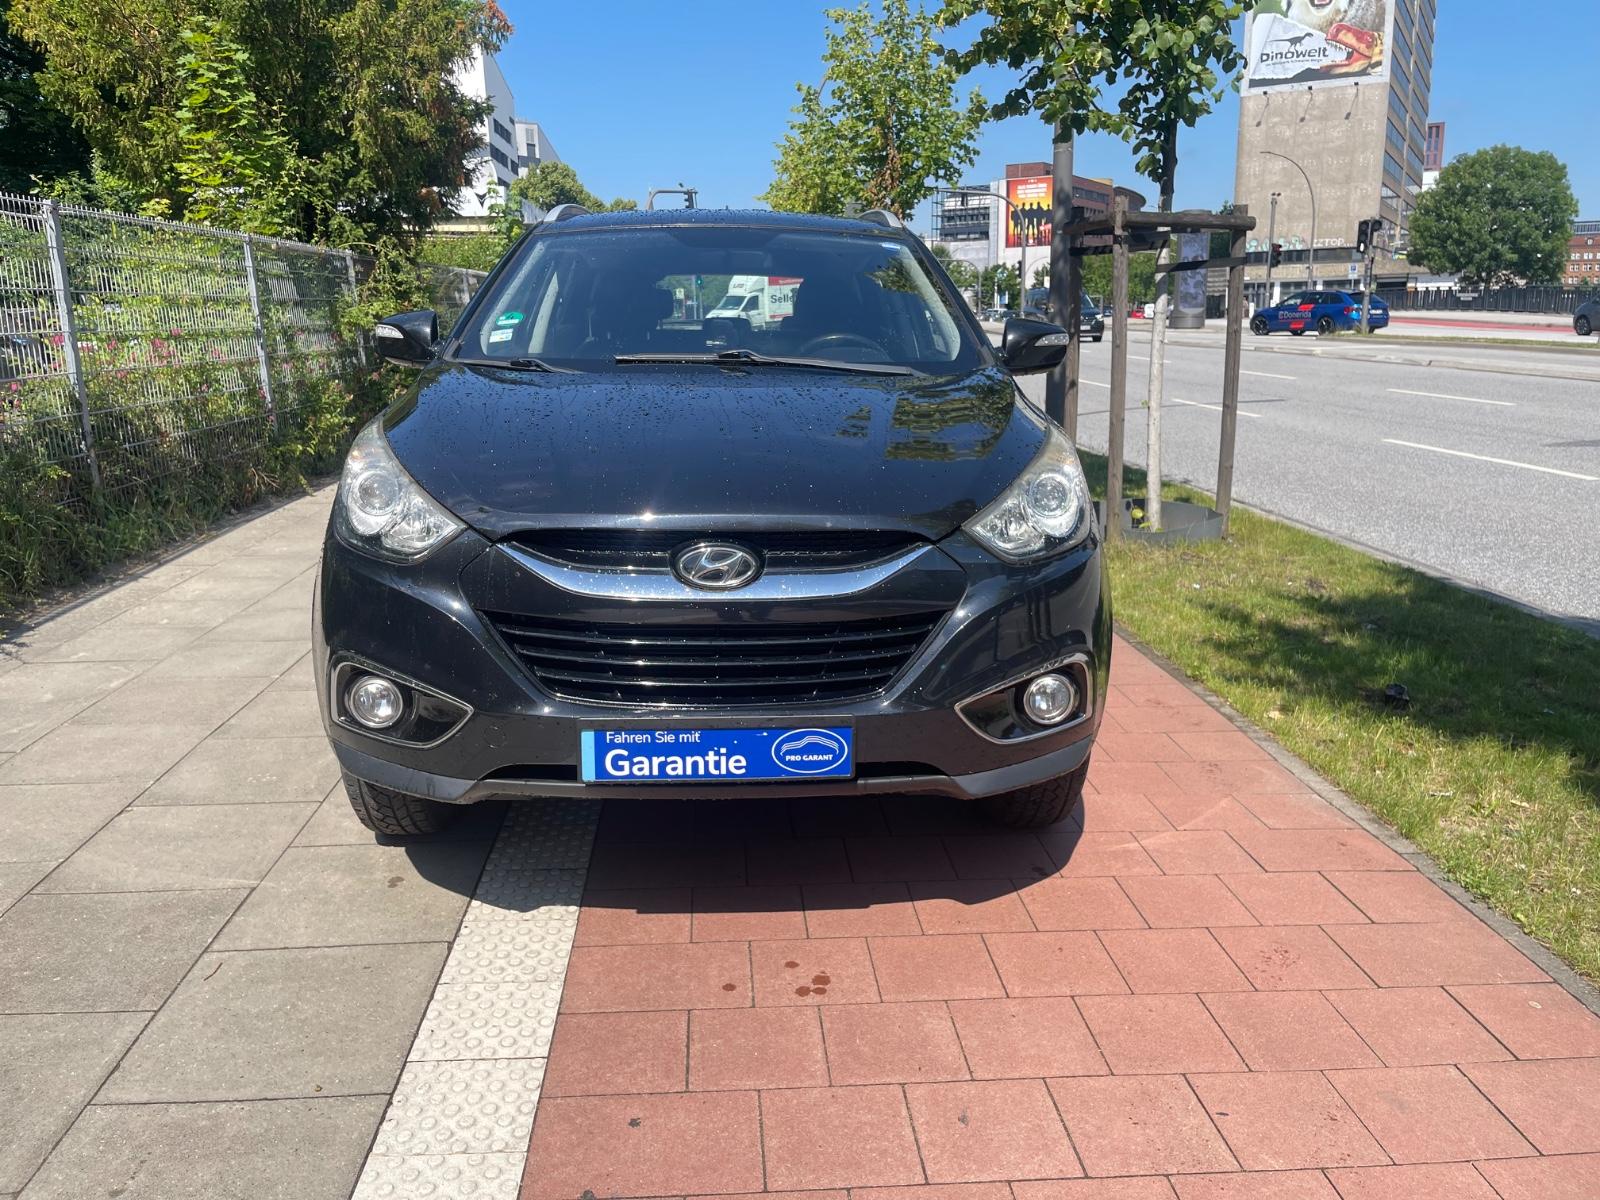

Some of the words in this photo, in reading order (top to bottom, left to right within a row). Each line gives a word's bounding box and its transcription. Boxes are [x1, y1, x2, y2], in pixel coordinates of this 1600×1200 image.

[1260, 47, 1329, 63] Dinowelt
[606, 731, 651, 743] Fahren
[655, 731, 675, 743] Sie
[679, 731, 701, 743] mit
[604, 748, 747, 776] Garantie
